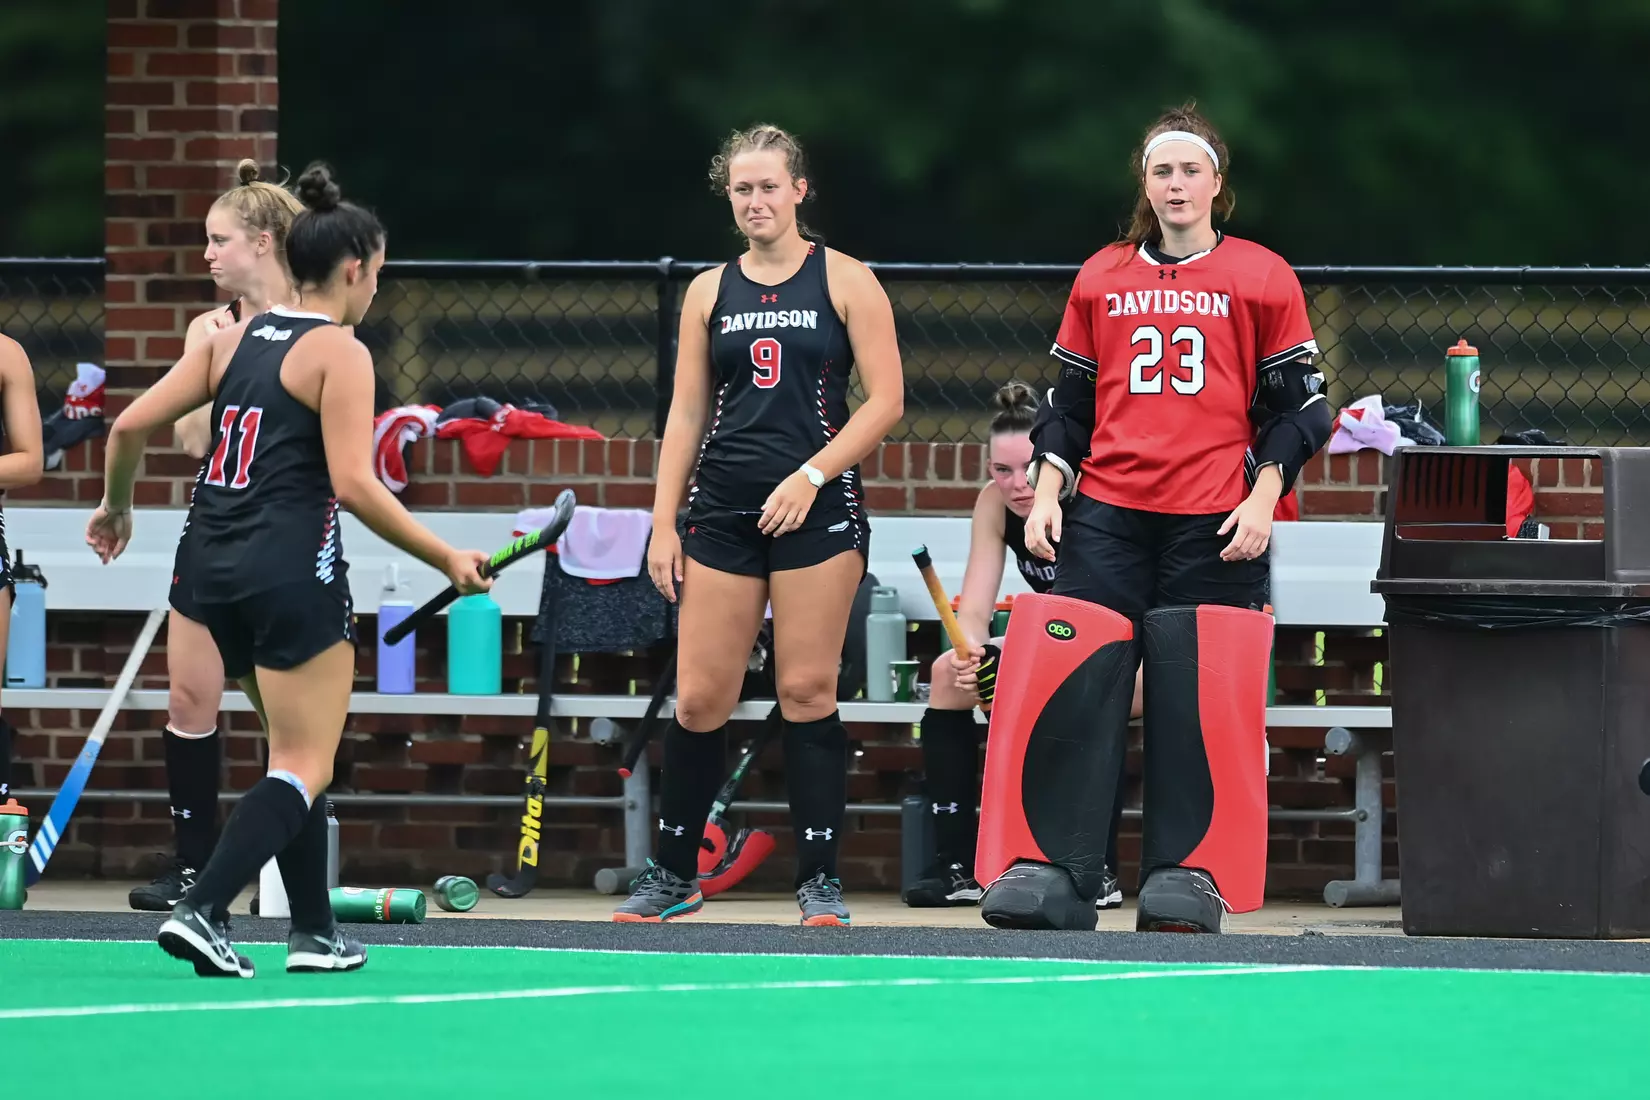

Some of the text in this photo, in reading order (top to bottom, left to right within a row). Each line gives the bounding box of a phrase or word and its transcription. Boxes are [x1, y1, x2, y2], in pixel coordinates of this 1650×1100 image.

[721, 309, 818, 334] DAVIDSON
[1105, 289, 1230, 318] DAVIDSON
[750, 337, 782, 389] 9
[1128, 324, 1206, 396] 23
[204, 404, 264, 489] 11
[1048, 623, 1072, 637] OBO
[518, 797, 542, 872] Dita
